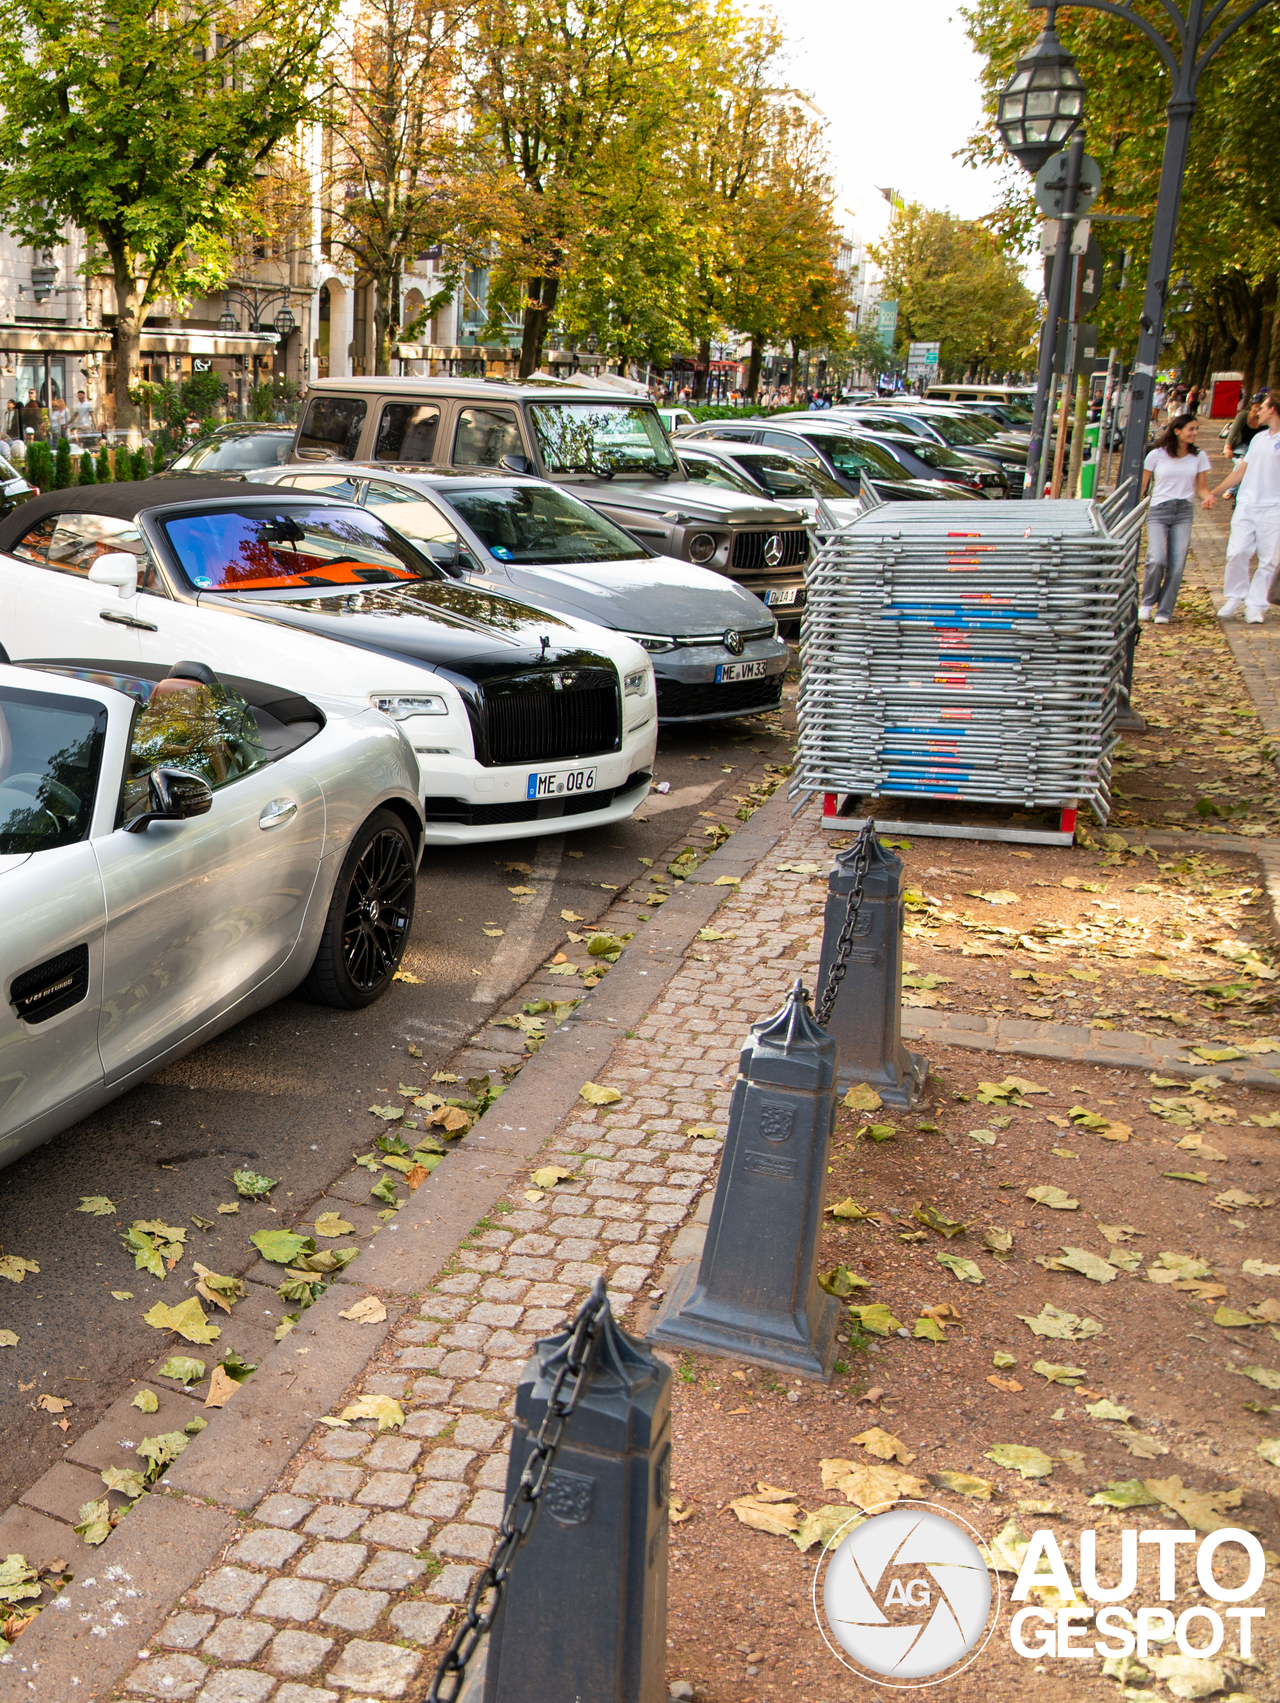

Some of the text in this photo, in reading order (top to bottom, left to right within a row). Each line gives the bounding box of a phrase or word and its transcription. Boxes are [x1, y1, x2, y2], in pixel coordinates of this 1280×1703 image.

[722, 665, 736, 681] ME
[742, 663, 754, 679] VM
[538, 775, 556, 795] ME
[586, 769, 594, 788] 6
